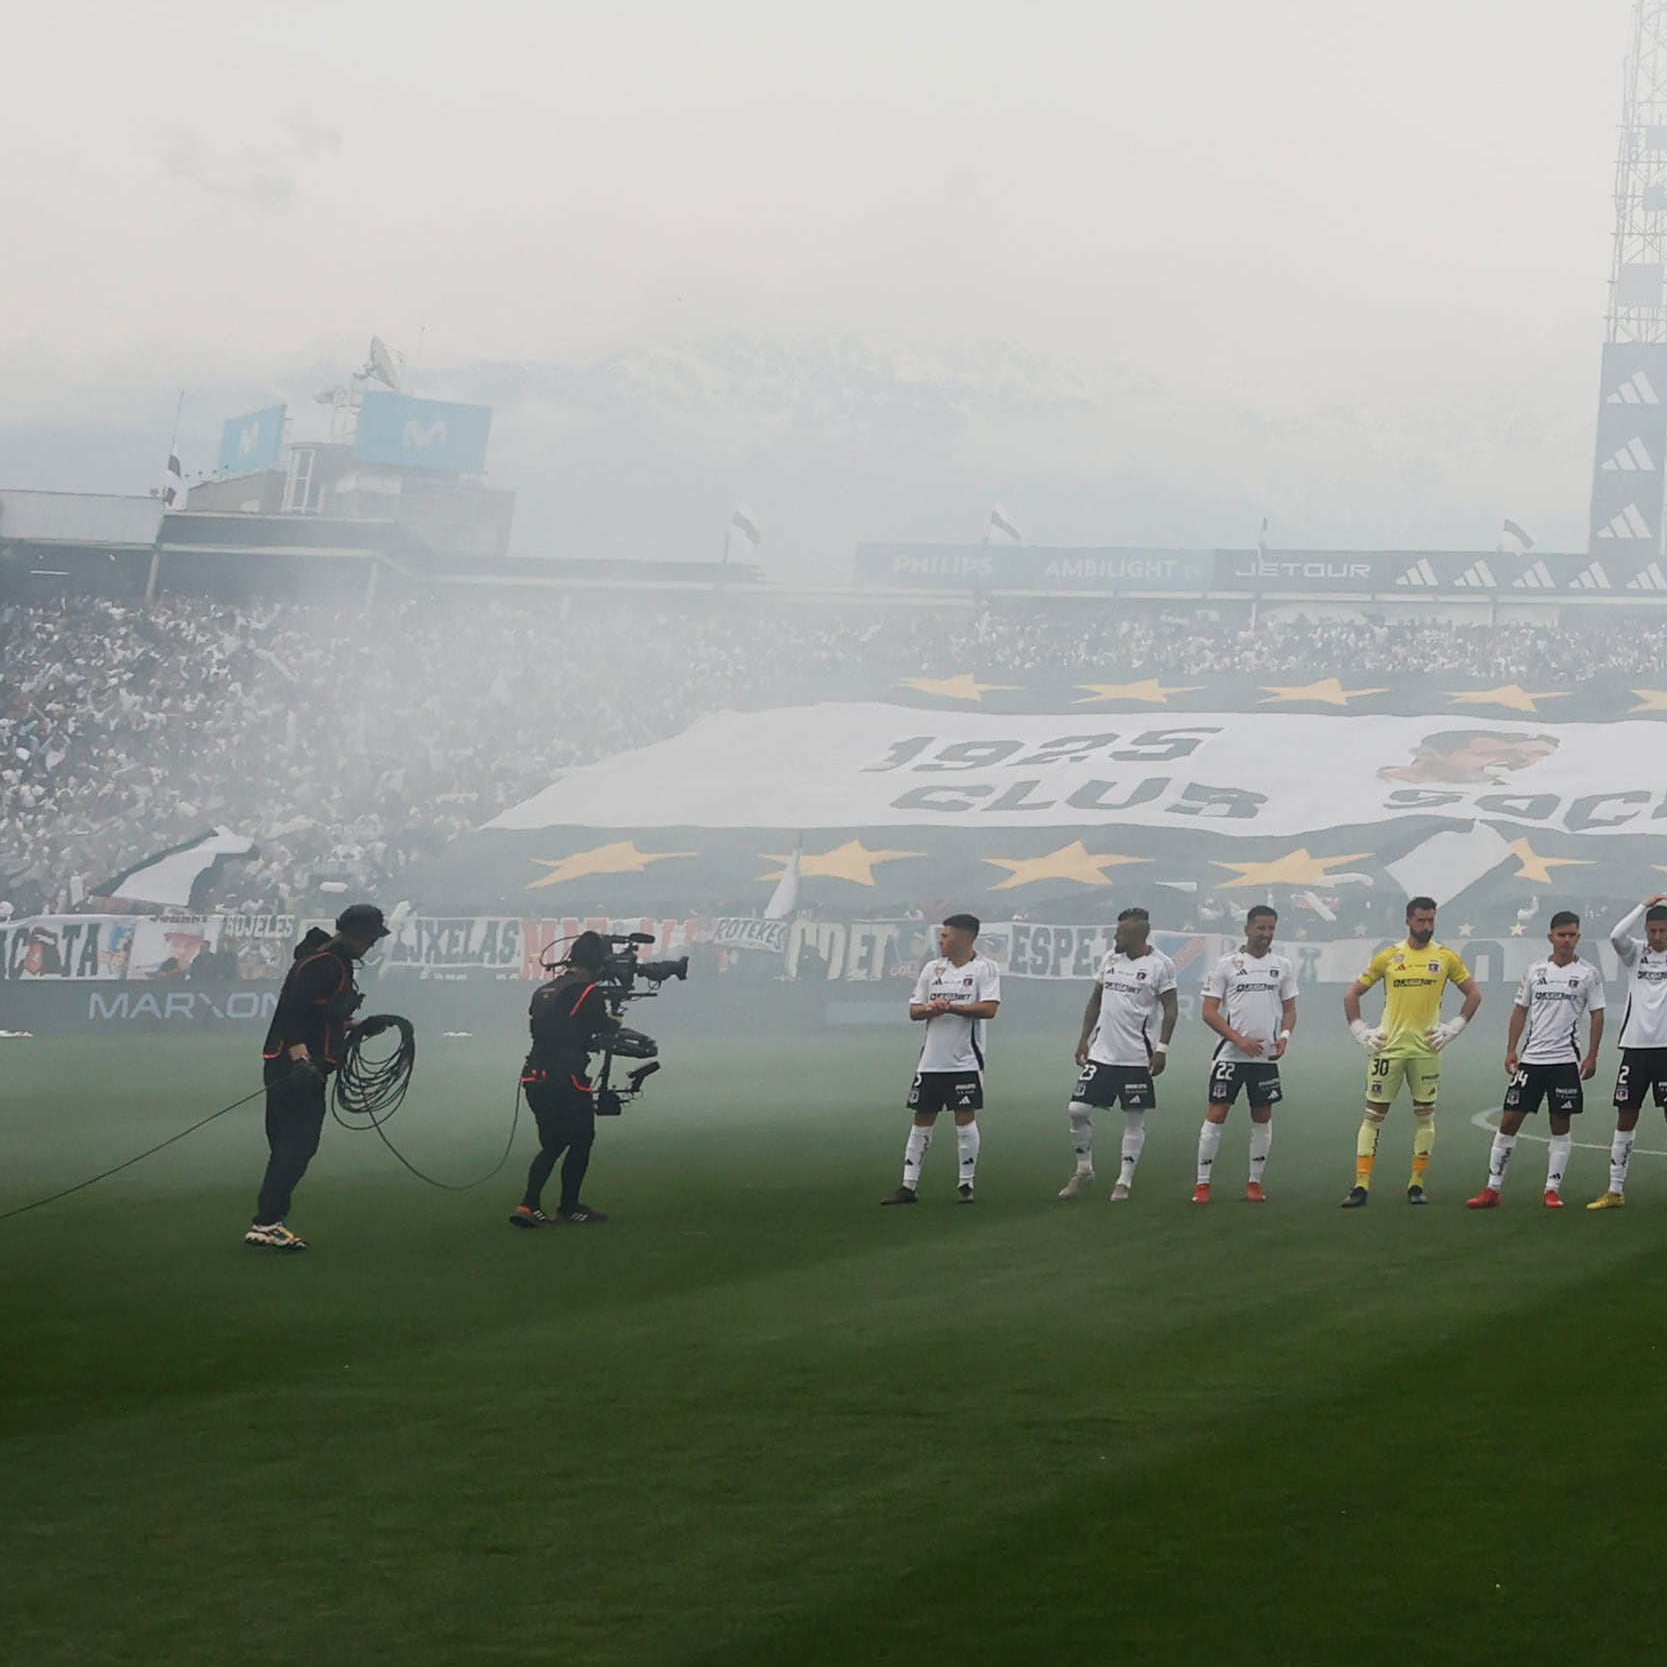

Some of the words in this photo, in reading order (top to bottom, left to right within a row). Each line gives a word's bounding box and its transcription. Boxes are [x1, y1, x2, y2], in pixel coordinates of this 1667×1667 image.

[893, 554, 993, 576] PHILIPS
[1044, 558, 1177, 579] AMBILIGHT
[1235, 561, 1372, 579] JETOUR
[858, 727, 1225, 773] 1925
[889, 776, 1270, 819] CLUB
[1215, 1062, 1236, 1081] 22
[1371, 1059, 1390, 1076] 30
